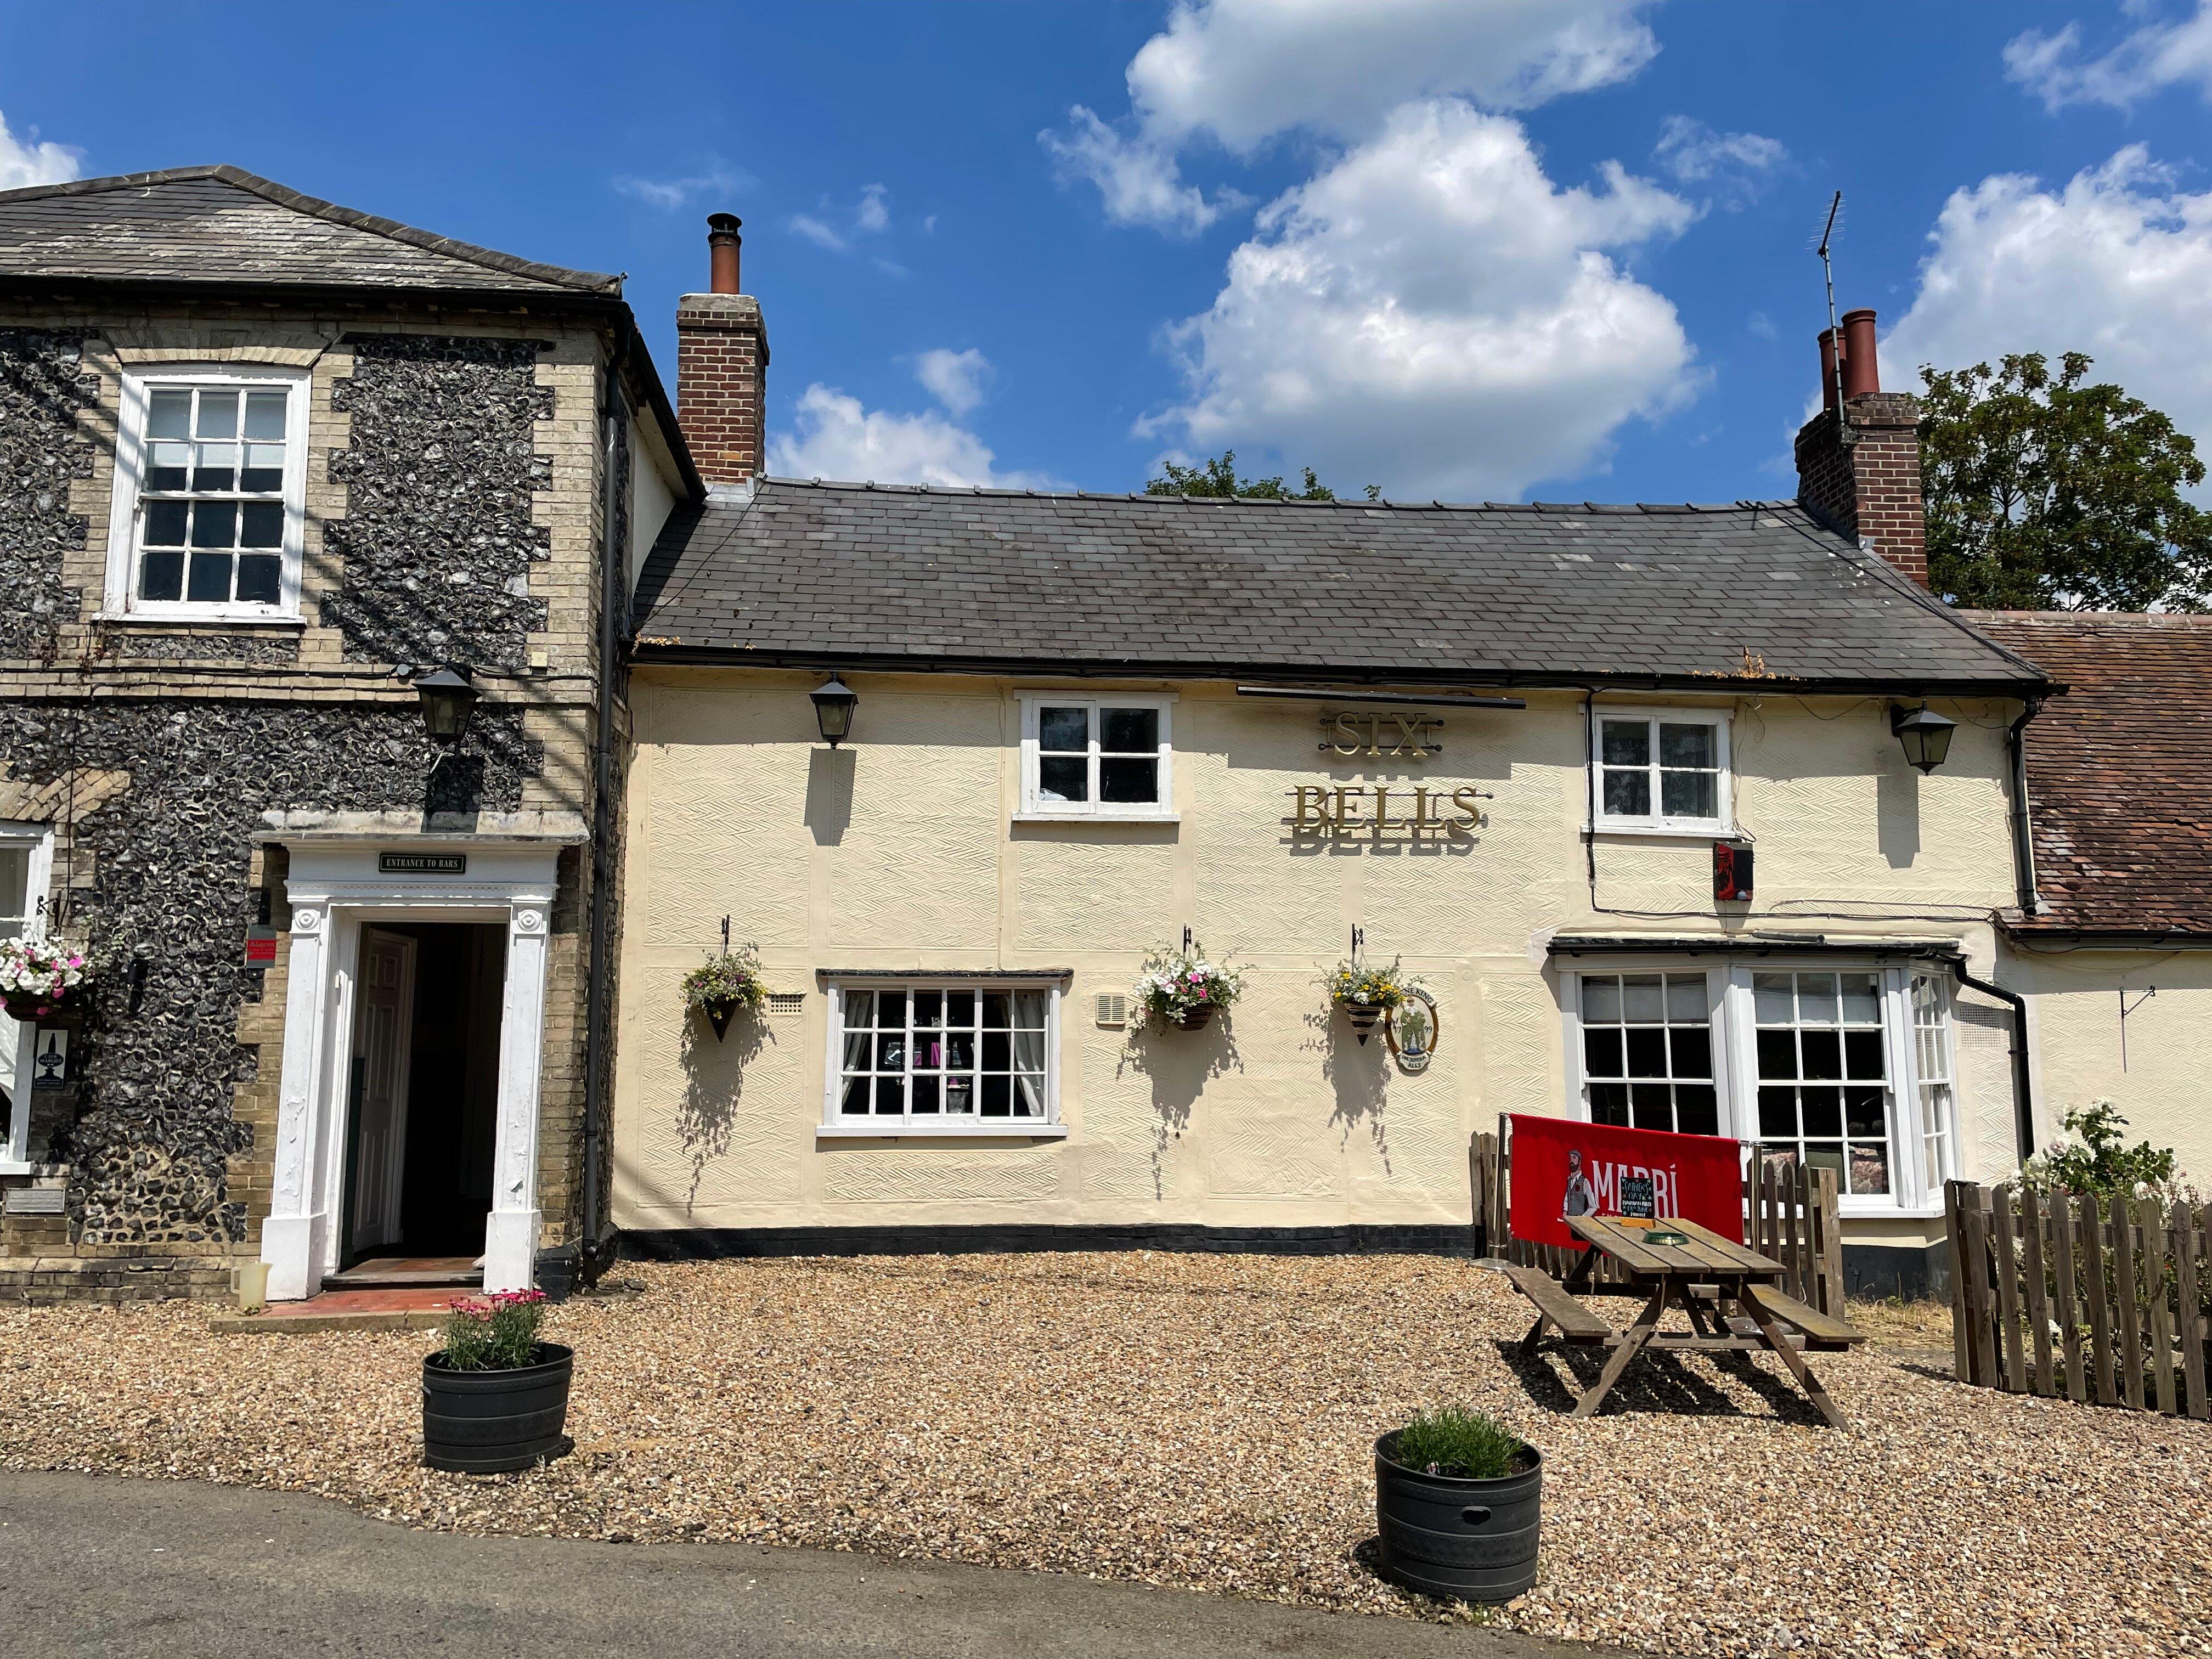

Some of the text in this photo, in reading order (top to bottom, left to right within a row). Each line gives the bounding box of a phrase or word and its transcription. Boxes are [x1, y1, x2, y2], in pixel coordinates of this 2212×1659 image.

[1334, 712, 1427, 757] SIX
[1294, 784, 1480, 830] BELLS
[386, 859, 424, 867] ENTRANCE
[439, 860, 458, 868] BARS
[1415, 989, 1434, 1003] KING
[1628, 1192, 1642, 1200] DAY
